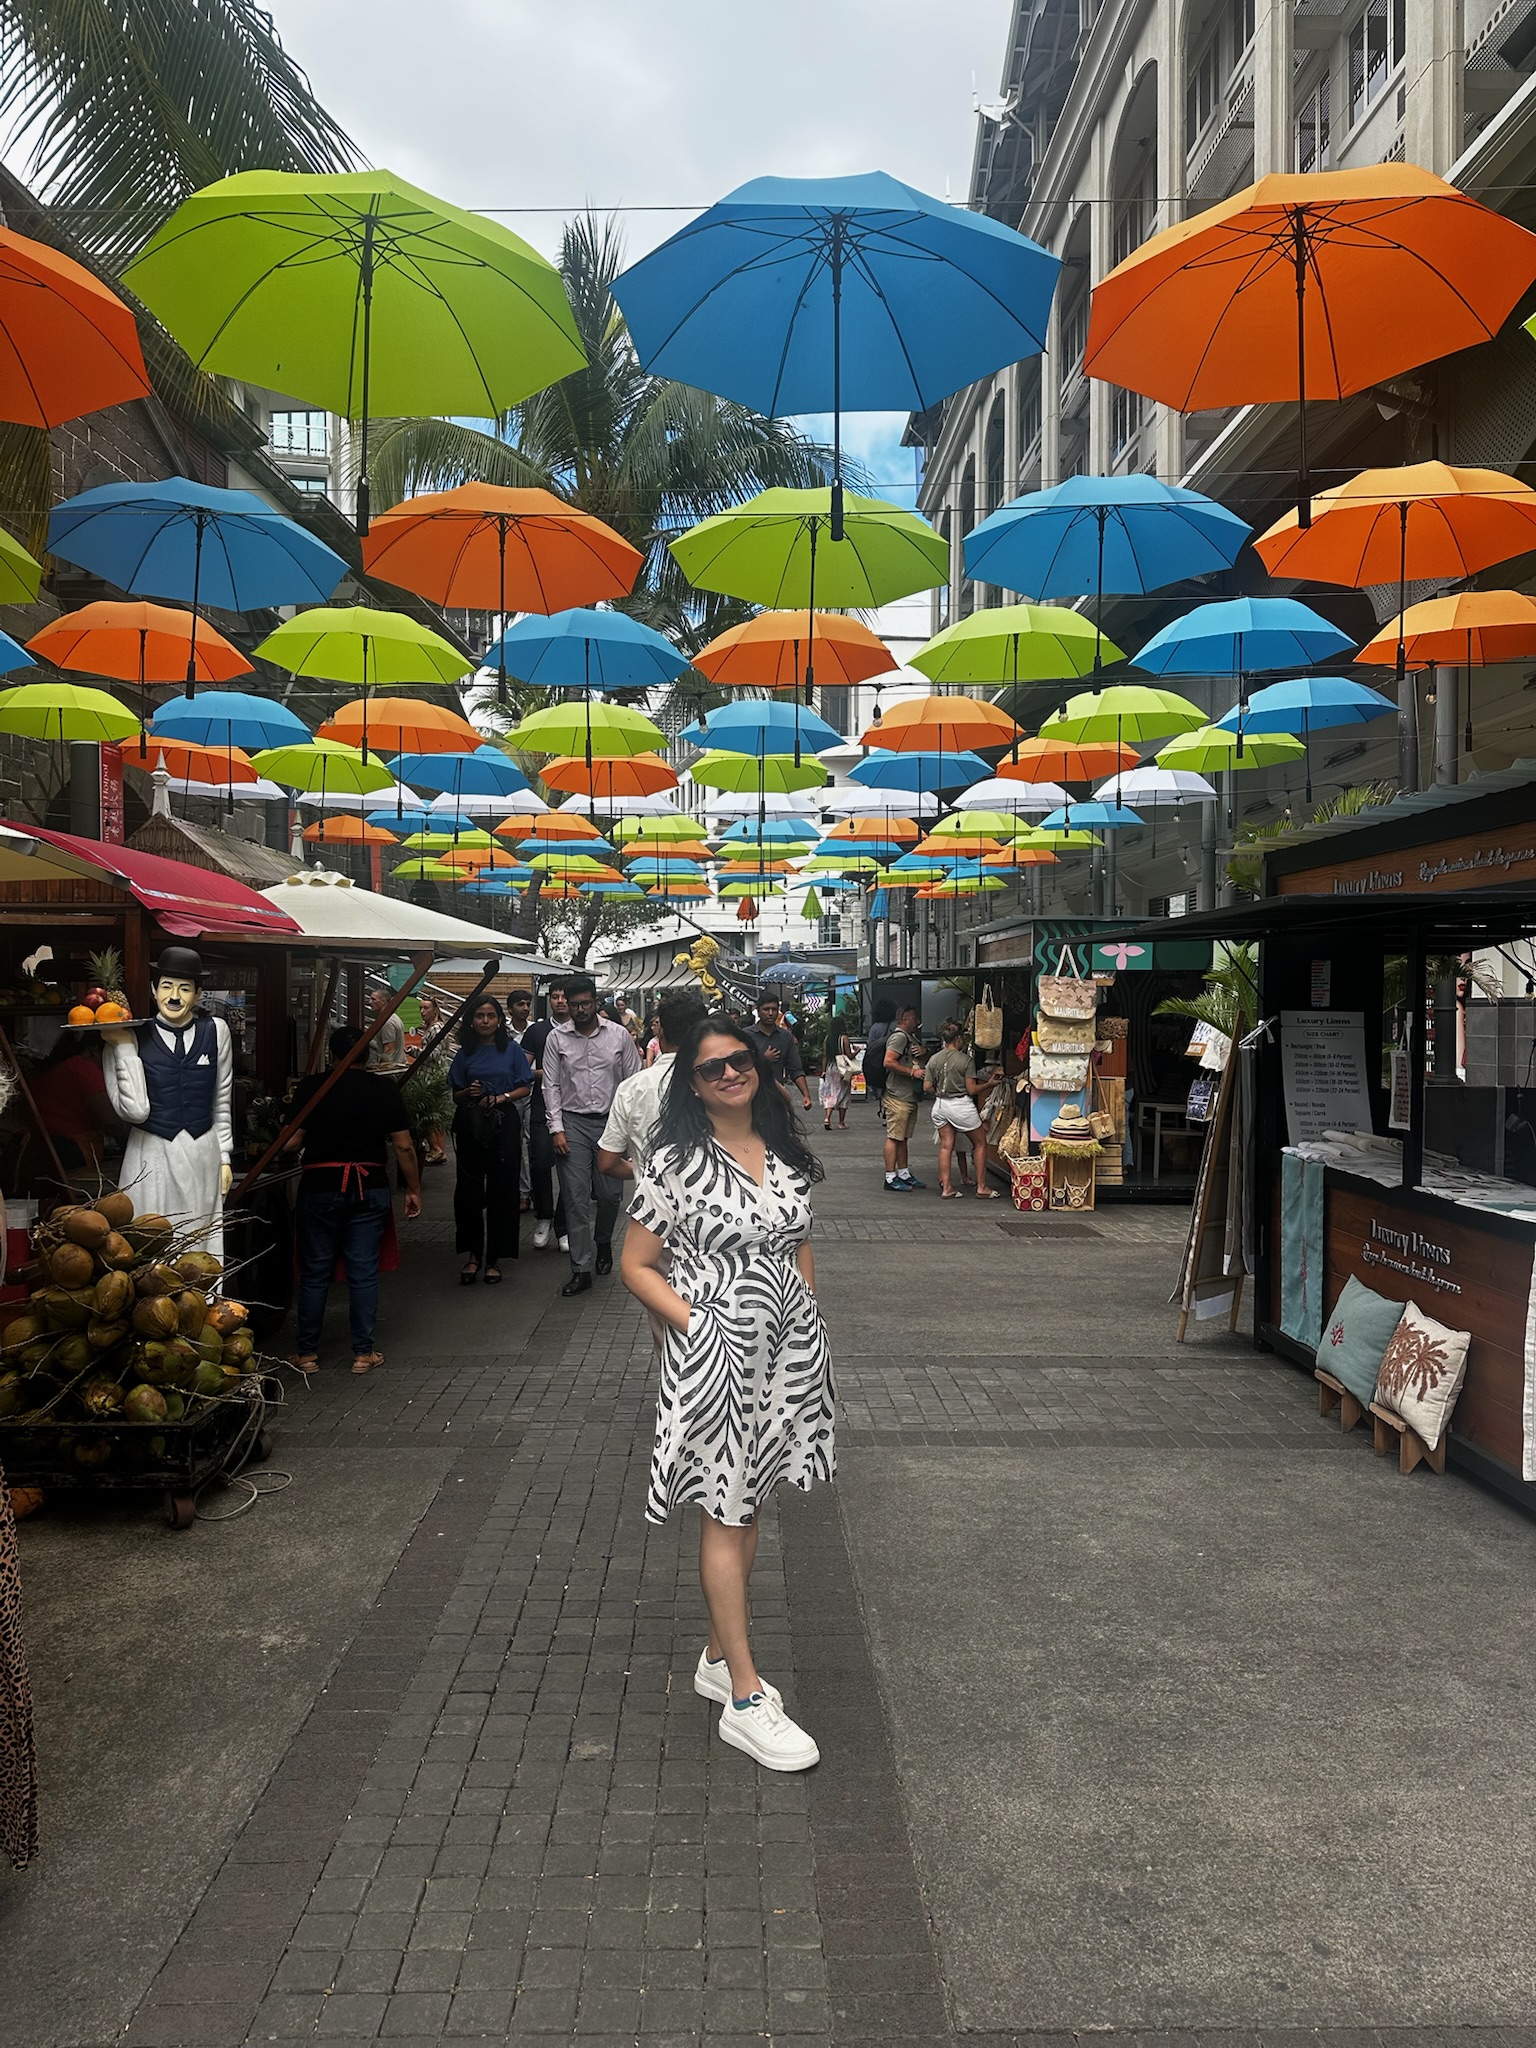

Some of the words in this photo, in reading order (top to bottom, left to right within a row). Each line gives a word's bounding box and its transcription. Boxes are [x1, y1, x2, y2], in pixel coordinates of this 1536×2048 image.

[1333, 878, 1367, 894] Luxury
[1369, 870, 1403, 891] Linens
[1053, 1006, 1087, 1017] MAURITIUS
[1296, 1017, 1325, 1026] Luxury
[1326, 1017, 1351, 1025] Linens
[1052, 1042, 1086, 1053] MAURITIUS
[1291, 1043, 1313, 1051] Rectangle
[1043, 1080, 1077, 1091] MAURITIUS
[1370, 1217, 1410, 1258] Luxury
[1411, 1231, 1451, 1265] Linens
